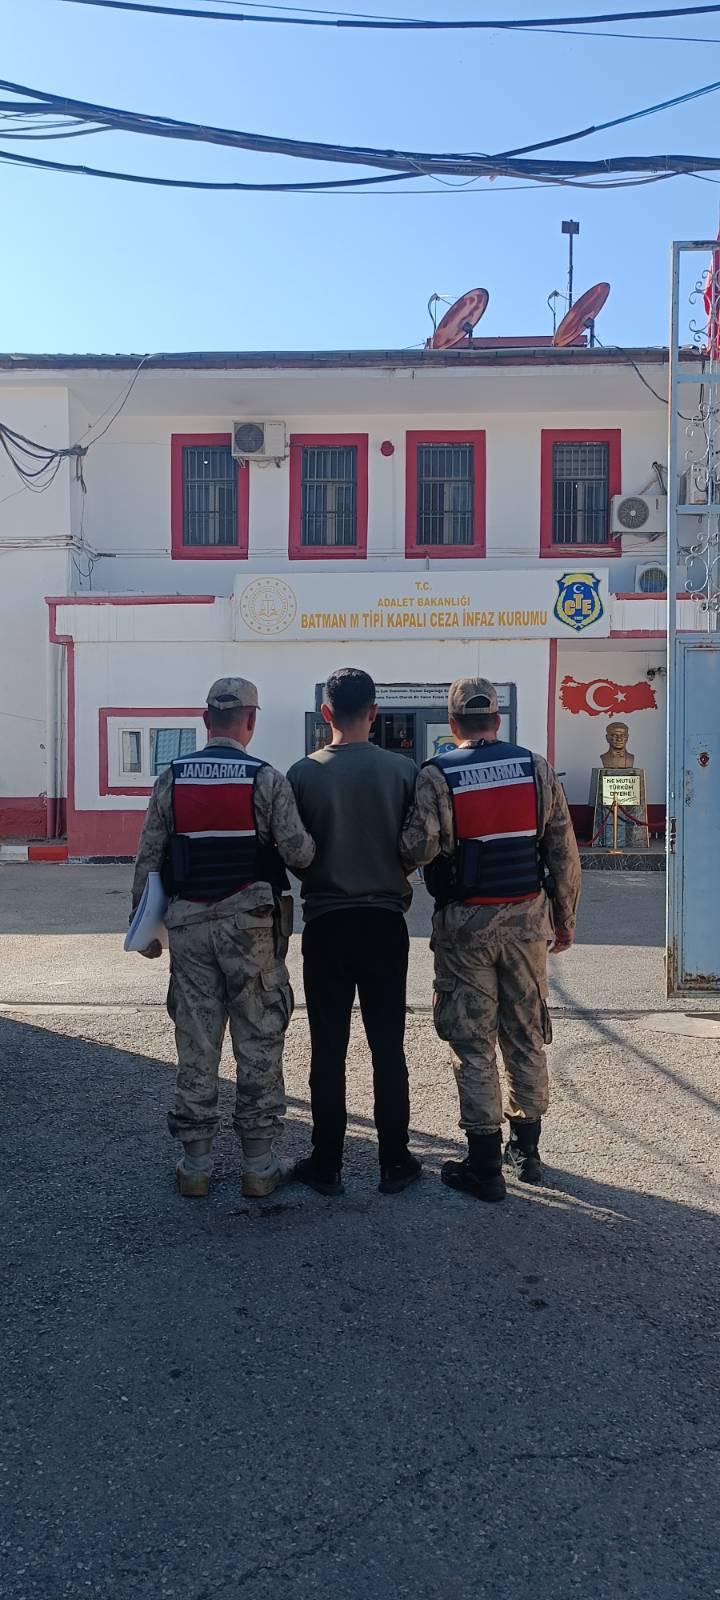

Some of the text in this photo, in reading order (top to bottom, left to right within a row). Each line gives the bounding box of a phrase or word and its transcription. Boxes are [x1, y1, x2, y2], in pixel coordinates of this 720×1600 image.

[415, 581, 432, 591] T.C.
[378, 595, 471, 607] ADALET BAKANLIĞI
[301, 609, 548, 628] BATMAN M TİPİ KAPALI CEZA İNFAZ KURUMU
[180, 763, 247, 778] JANDARMA
[459, 763, 525, 785] JANDARMA
